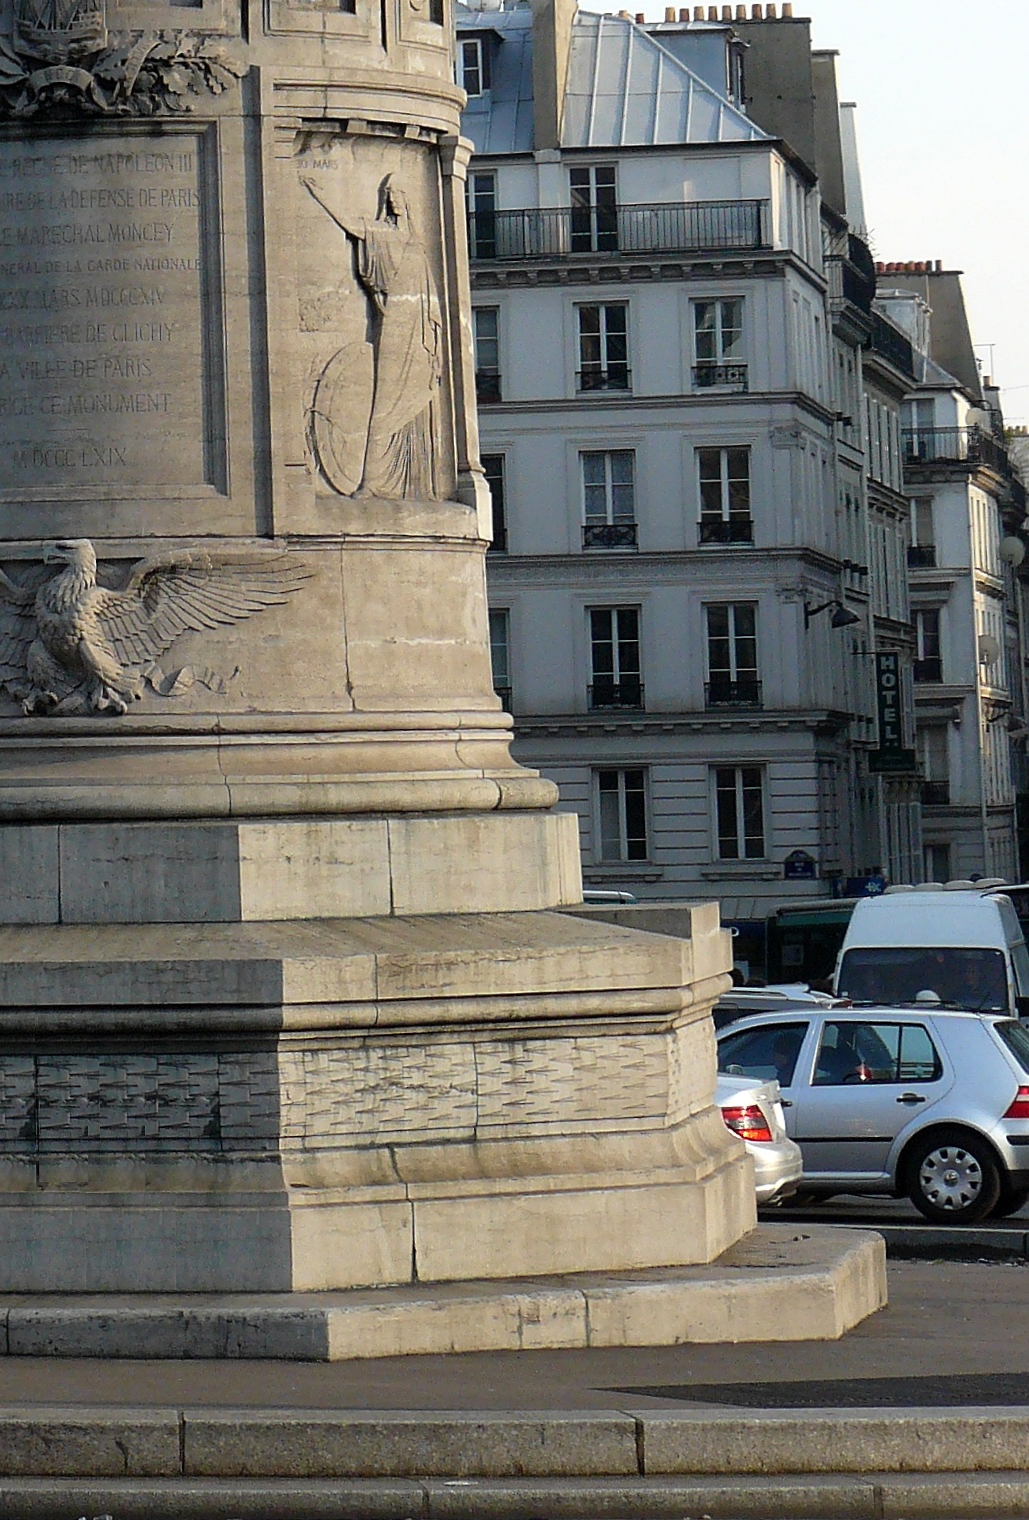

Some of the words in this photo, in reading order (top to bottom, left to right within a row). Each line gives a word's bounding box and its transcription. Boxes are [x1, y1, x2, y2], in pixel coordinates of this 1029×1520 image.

[68, 155, 90, 174] DE
[96, 153, 174, 174] NAPOLEON
[178, 154, 192, 172] III
[312, 158, 339, 170] MARS
[48, 191, 69, 210] LA
[70, 188, 135, 209] DEFENSE
[138, 188, 157, 208] DE
[160, 188, 202, 207] PARIS
[16, 223, 105, 247] MARECHAL
[108, 223, 174, 243] MONCEY
[44, 260, 62, 274] DE
[65, 260, 83, 273] LA
[87, 259, 130, 272] GARDE
[133, 258, 201, 272] NATIONALE
[85, 323, 107, 344] DE
[112, 322, 175, 343] CLICHY
[15, 360, 67, 381] VILLE
[72, 358, 96, 379] DE
[101, 357, 152, 378] PARIS
[38, 395, 62, 416] CE
[66, 392, 172, 415] MONUMENT
[879, 655, 898, 740] HOTEL
